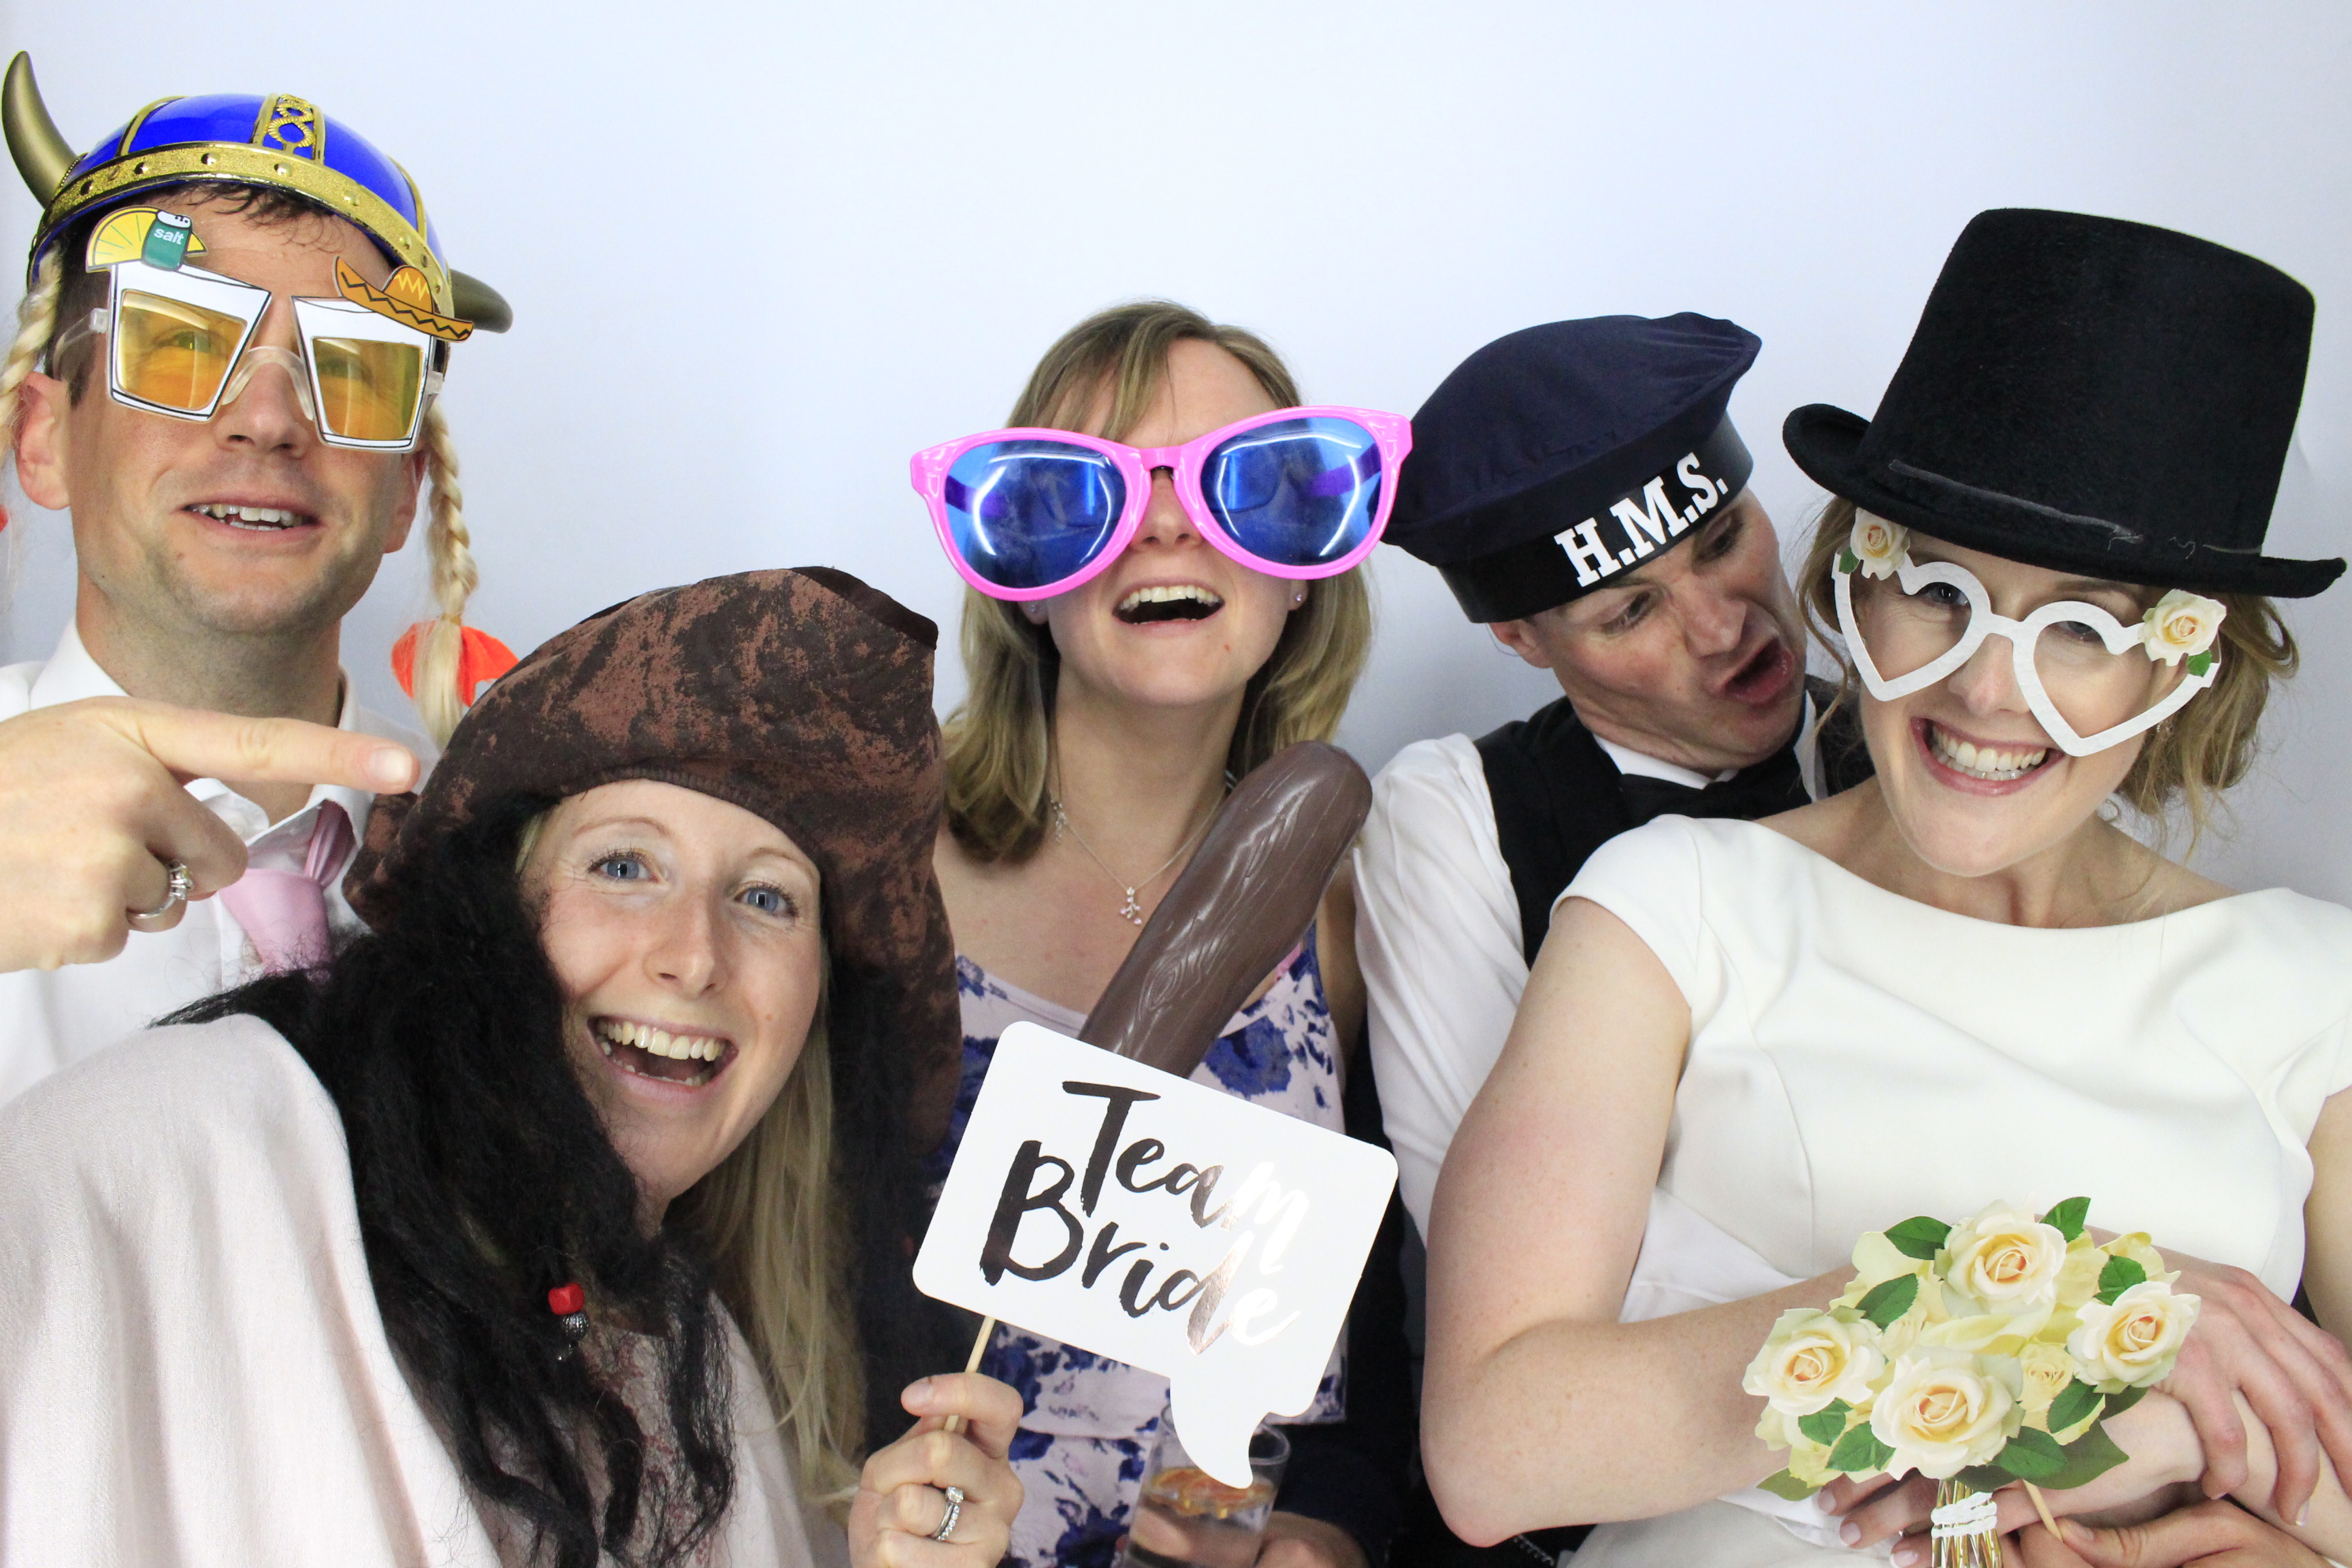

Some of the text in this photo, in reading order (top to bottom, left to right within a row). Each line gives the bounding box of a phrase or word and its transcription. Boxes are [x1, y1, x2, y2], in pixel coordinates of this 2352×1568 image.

[153, 227, 184, 245] salt
[1553, 452, 1729, 587] H.M.S.
[979, 1139, 1301, 1356] Bride
[1062, 1080, 1310, 1275] Team
